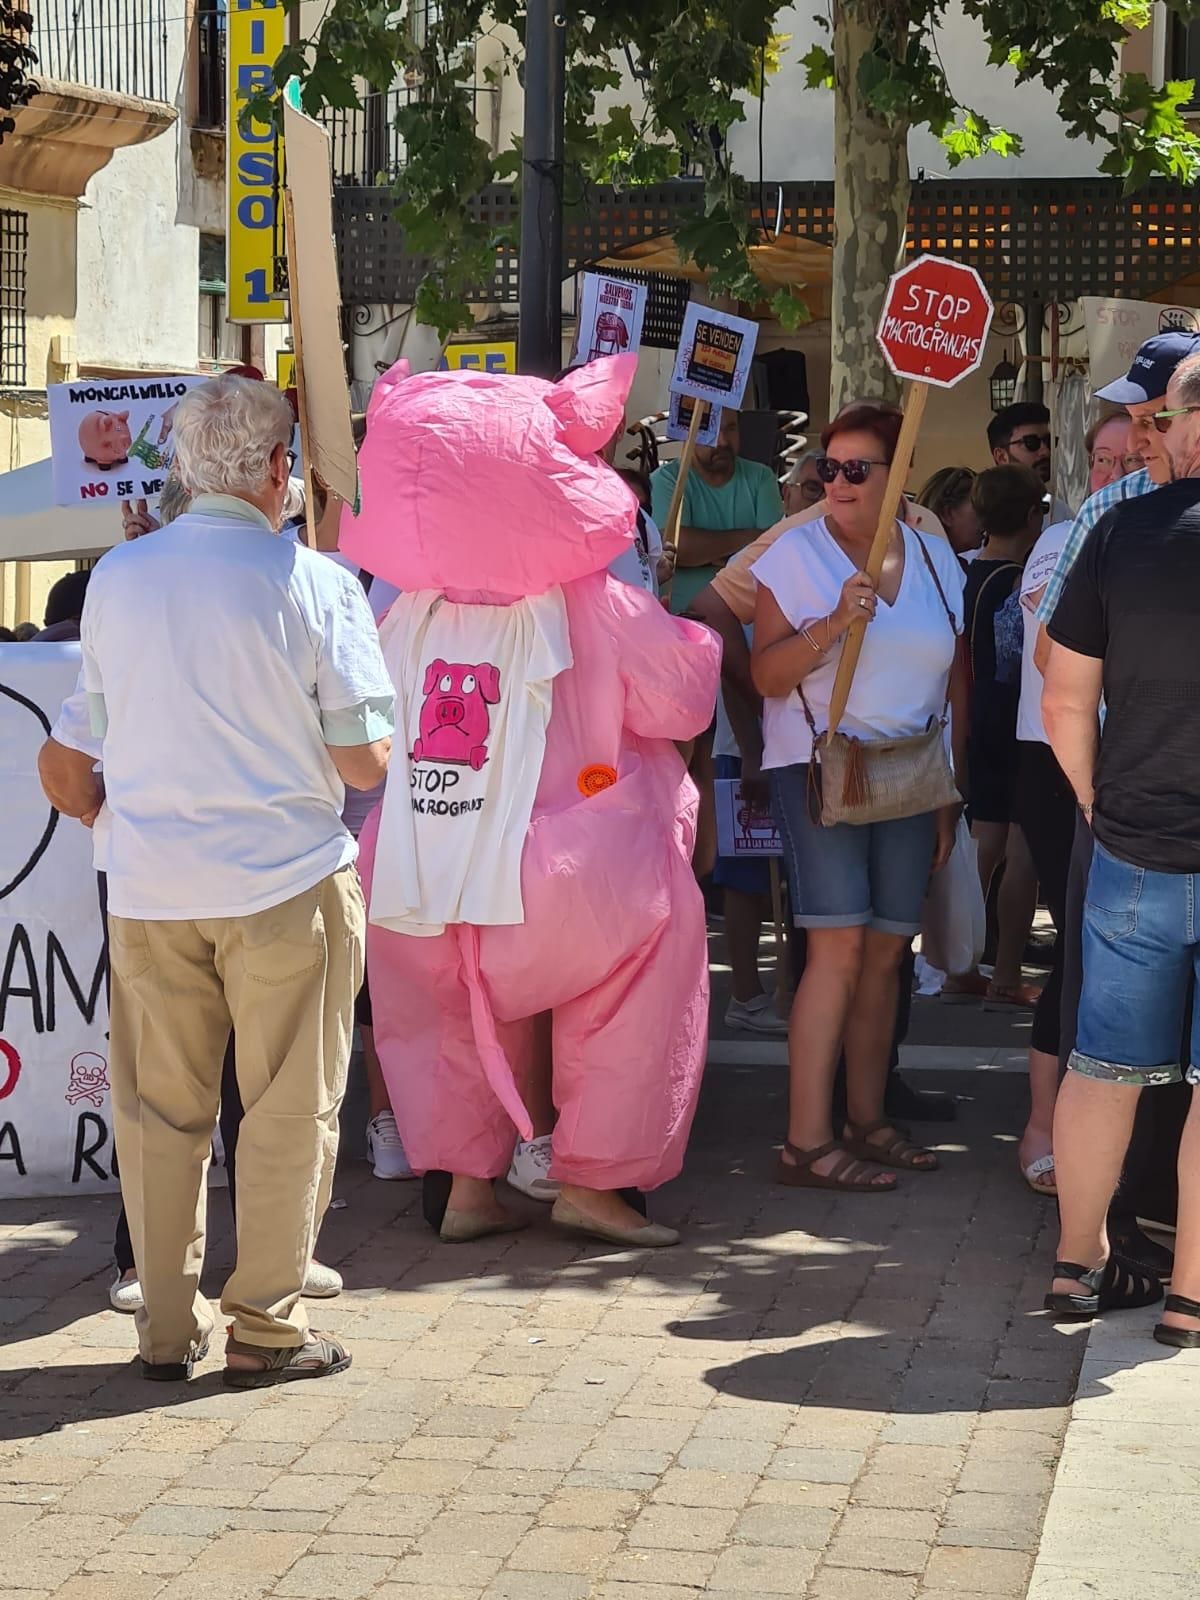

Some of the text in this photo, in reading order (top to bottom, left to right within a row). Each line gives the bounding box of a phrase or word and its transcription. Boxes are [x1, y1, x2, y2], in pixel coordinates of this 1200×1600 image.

[245, 269, 270, 303] 1
[903, 284, 971, 323] STOP
[696, 324, 742, 353] SE VENDEN
[882, 316, 981, 362] MACROGRANJAS
[69, 382, 188, 404] MONCALVILLO
[80, 481, 109, 499] NO
[117, 480, 133, 496] SE
[410, 767, 460, 794] STOP
